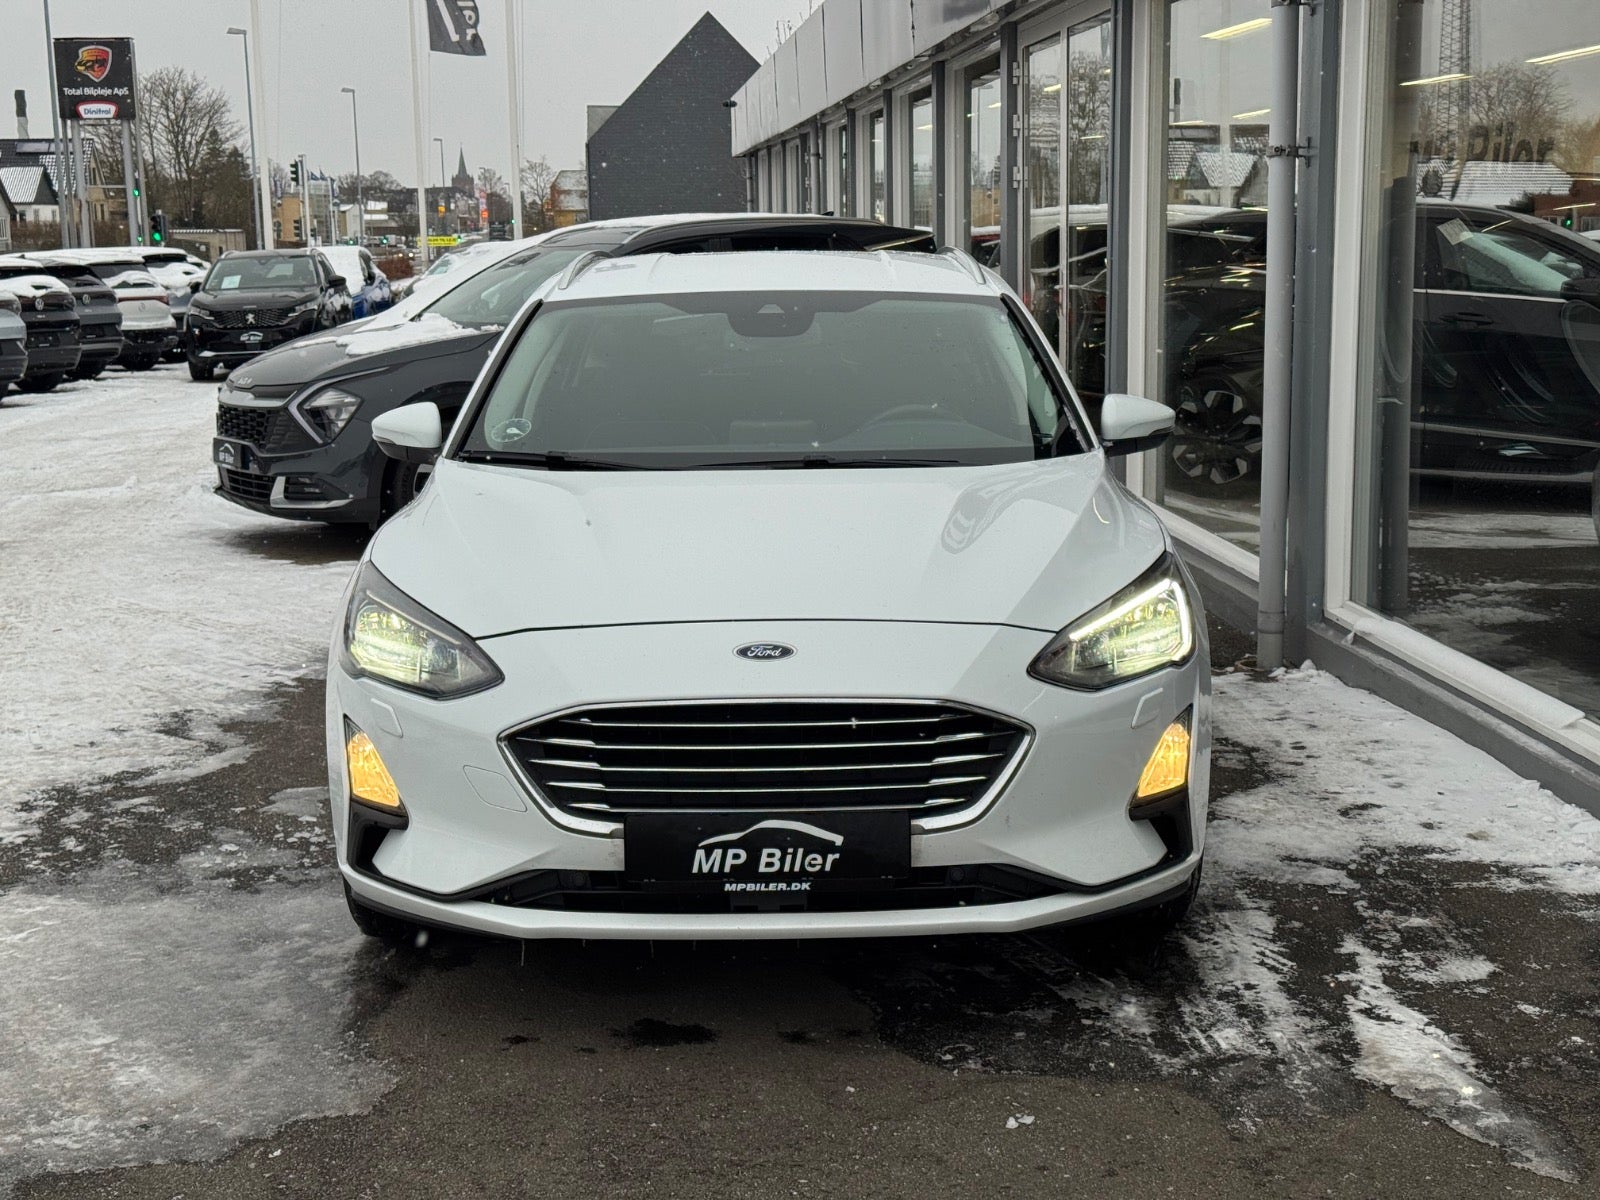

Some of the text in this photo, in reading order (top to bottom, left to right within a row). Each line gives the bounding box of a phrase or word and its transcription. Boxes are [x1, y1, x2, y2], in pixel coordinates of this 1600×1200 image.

[63, 87, 83, 96] Total
[113, 87, 129, 96] ApS
[84, 108, 112, 116] Dinitrol
[747, 645, 782, 657] Ford
[692, 847, 840, 873] MP Biler
[724, 882, 812, 892] MPBILER.DK
